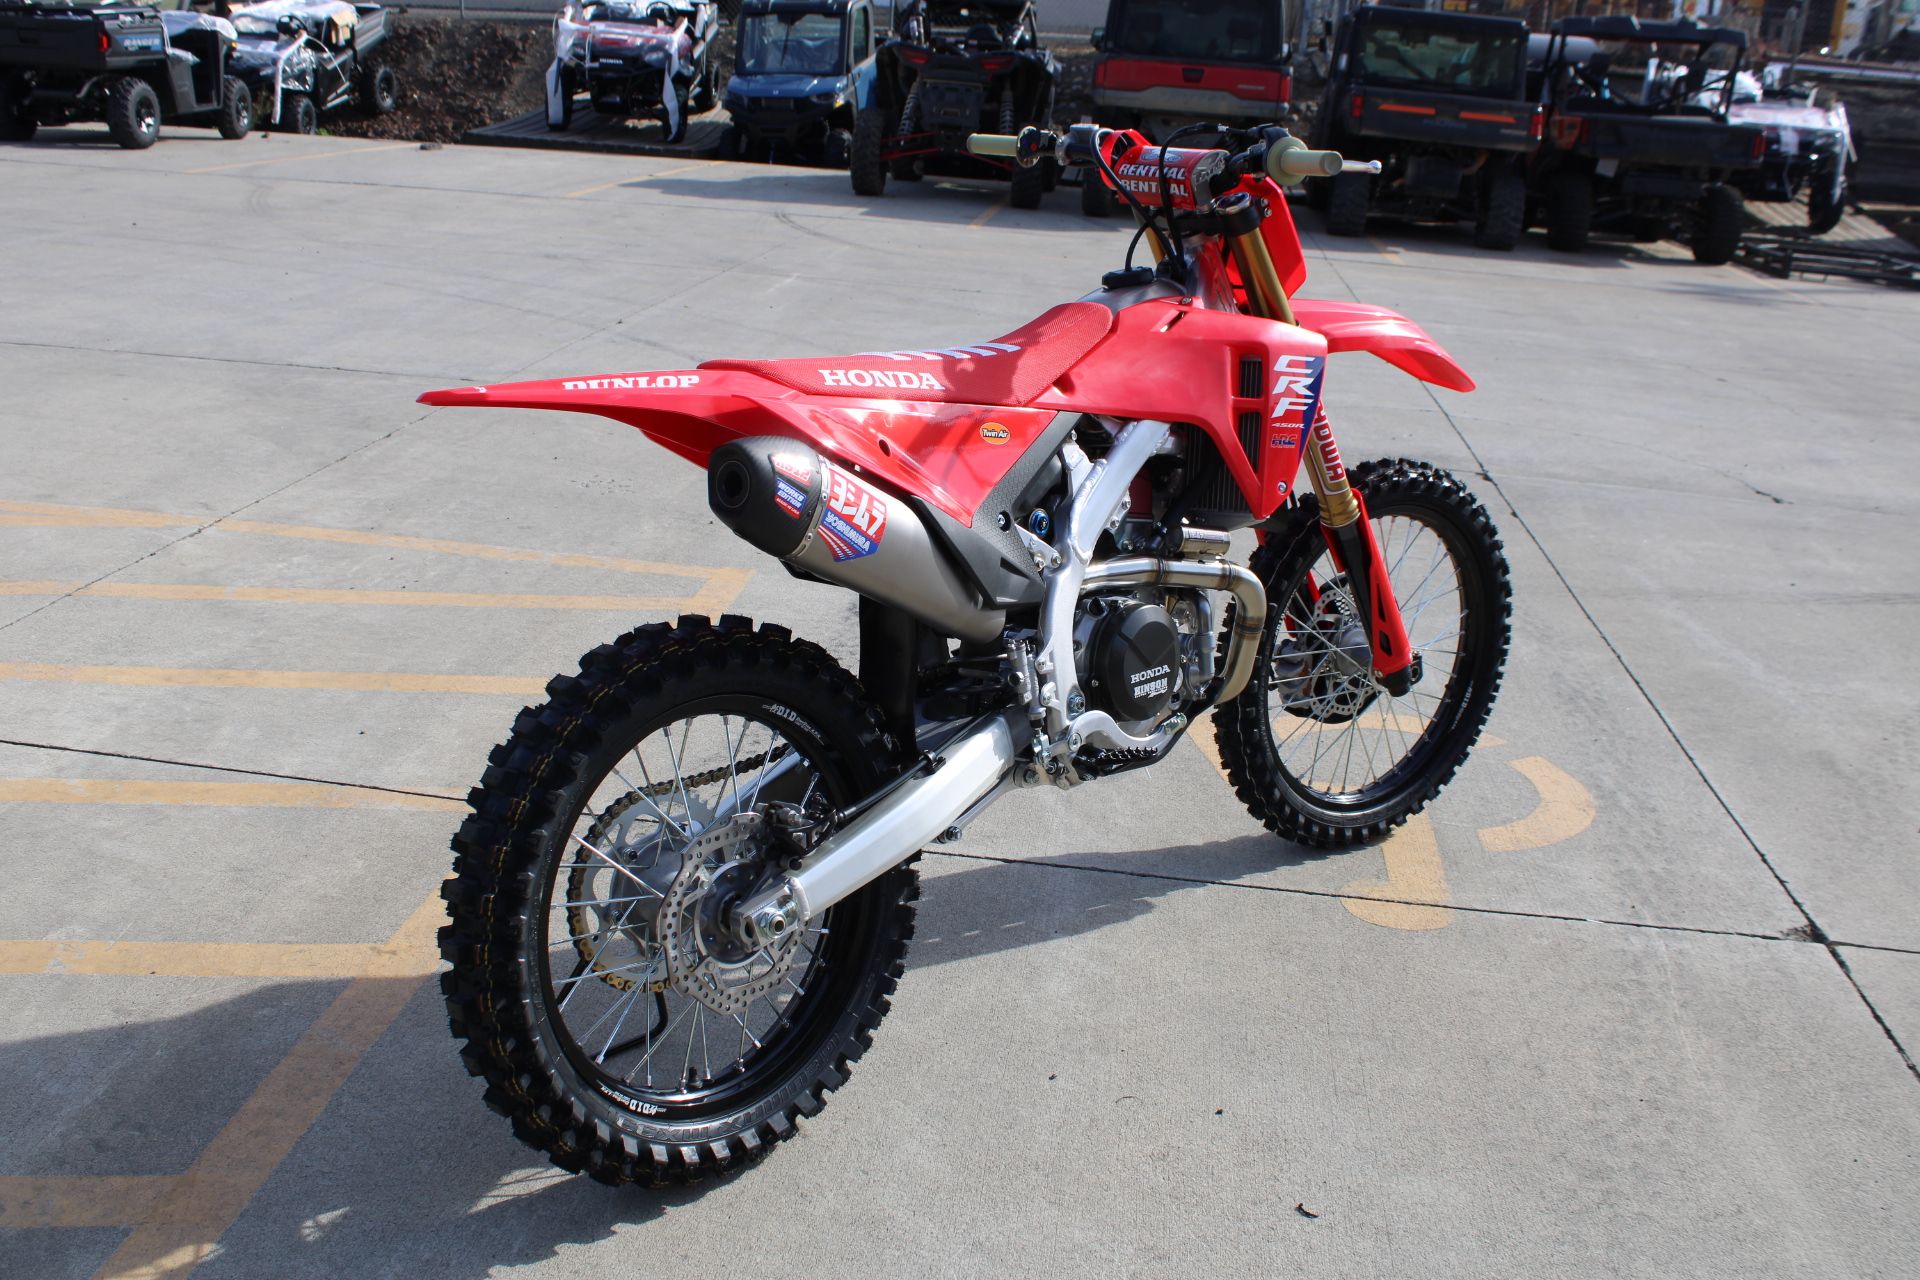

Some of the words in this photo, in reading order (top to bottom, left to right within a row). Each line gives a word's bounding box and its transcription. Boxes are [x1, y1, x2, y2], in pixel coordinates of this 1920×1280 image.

[1120, 178, 1189, 198] RENTAL
[562, 375, 700, 390] DUNLOP
[818, 368, 946, 391] HONDA
[982, 427, 998, 438] Twin
[998, 429, 1009, 438] Air
[1313, 399, 1346, 484] HOWA
[777, 480, 805, 502] WORKS
[824, 511, 871, 552] YOSHIMURA
[1130, 664, 1171, 684] HONDA
[1133, 678, 1168, 697] HINSON
